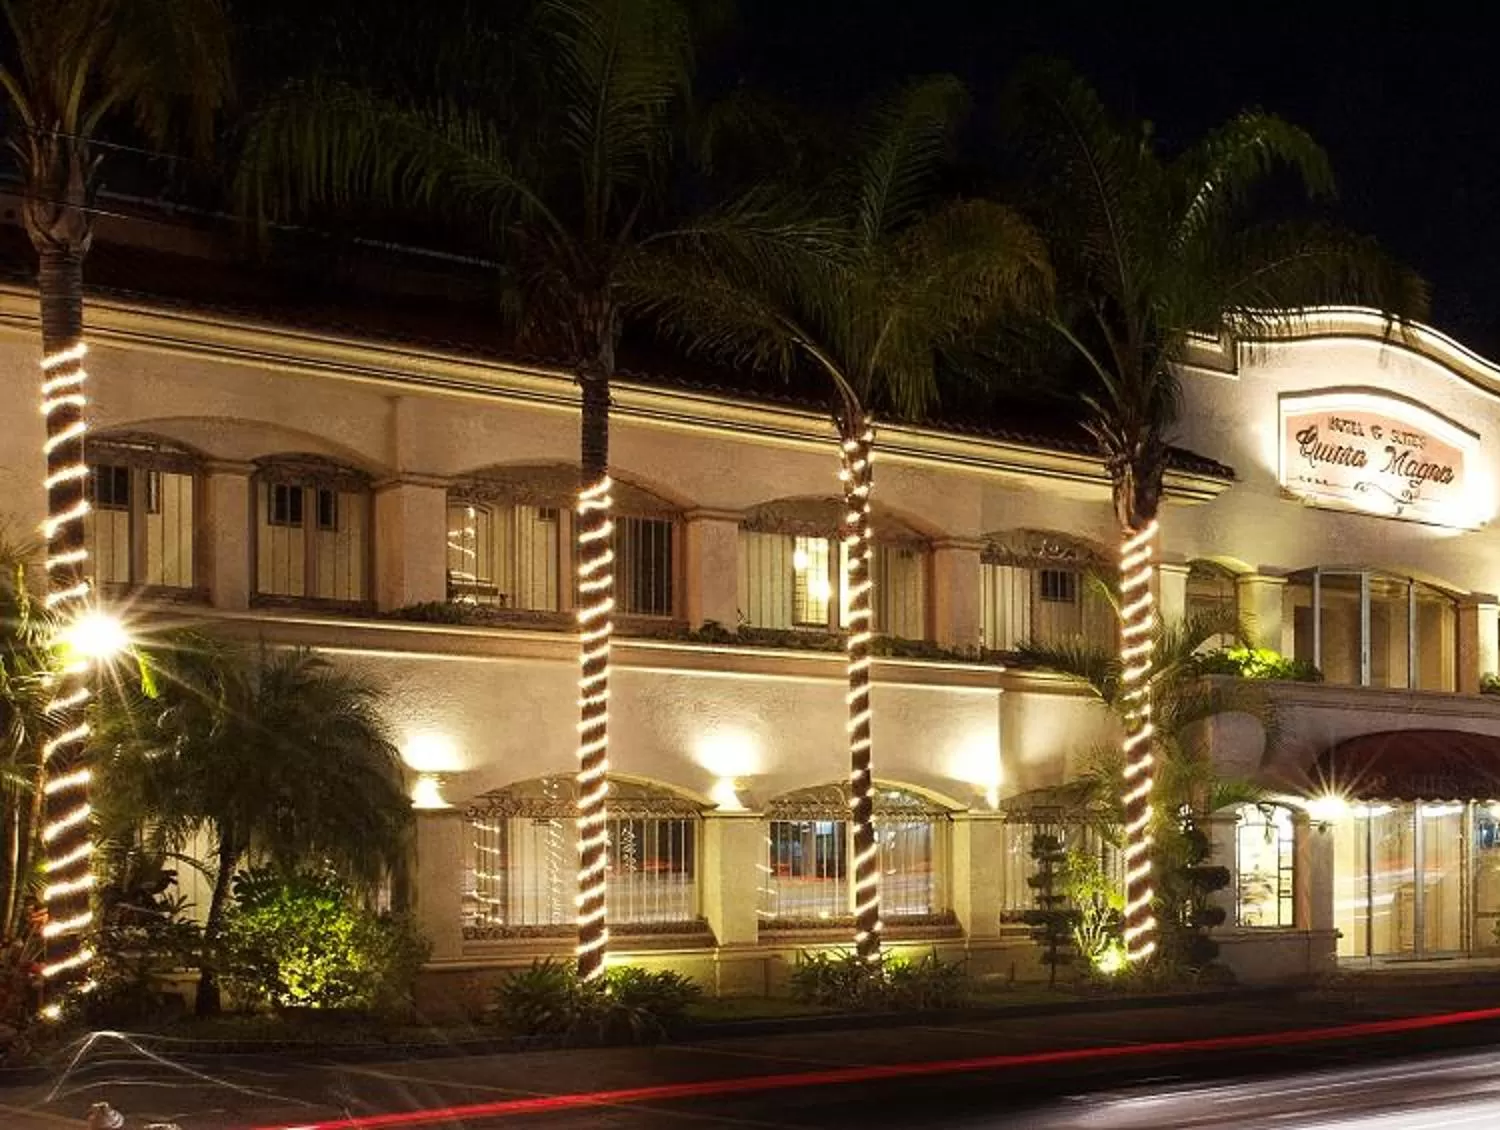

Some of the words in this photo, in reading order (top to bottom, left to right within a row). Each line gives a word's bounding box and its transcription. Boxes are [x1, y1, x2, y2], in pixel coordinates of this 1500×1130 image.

[1295, 424, 1368, 469] Quinta
[1379, 445, 1454, 488] Magna
[1328, 416, 1365, 437] HOTEL
[1391, 429, 1428, 449] SUITES
